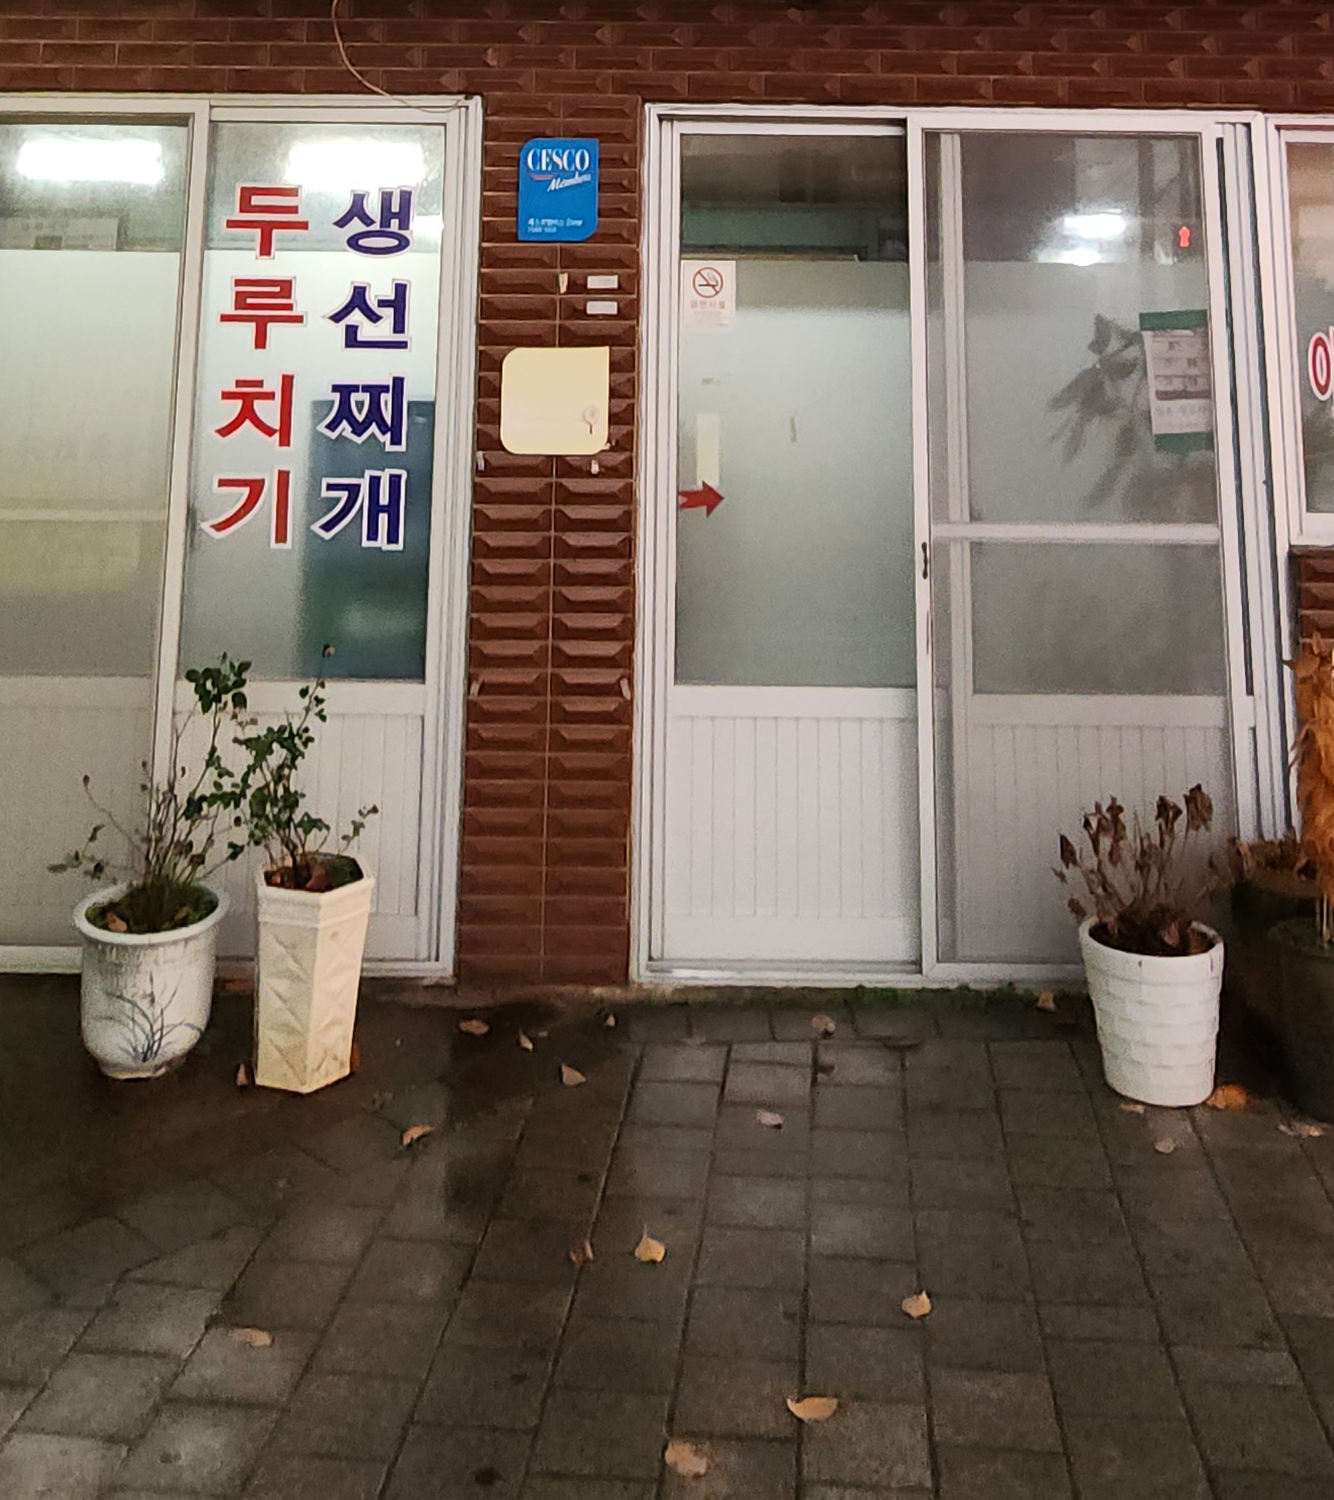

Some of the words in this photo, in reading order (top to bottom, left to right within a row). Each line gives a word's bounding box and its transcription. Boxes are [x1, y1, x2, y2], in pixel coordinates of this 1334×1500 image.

[527, 148, 590, 172] CESCO
[201, 184, 310, 550] 두루치기
[310, 185, 415, 552] 생선찌개
